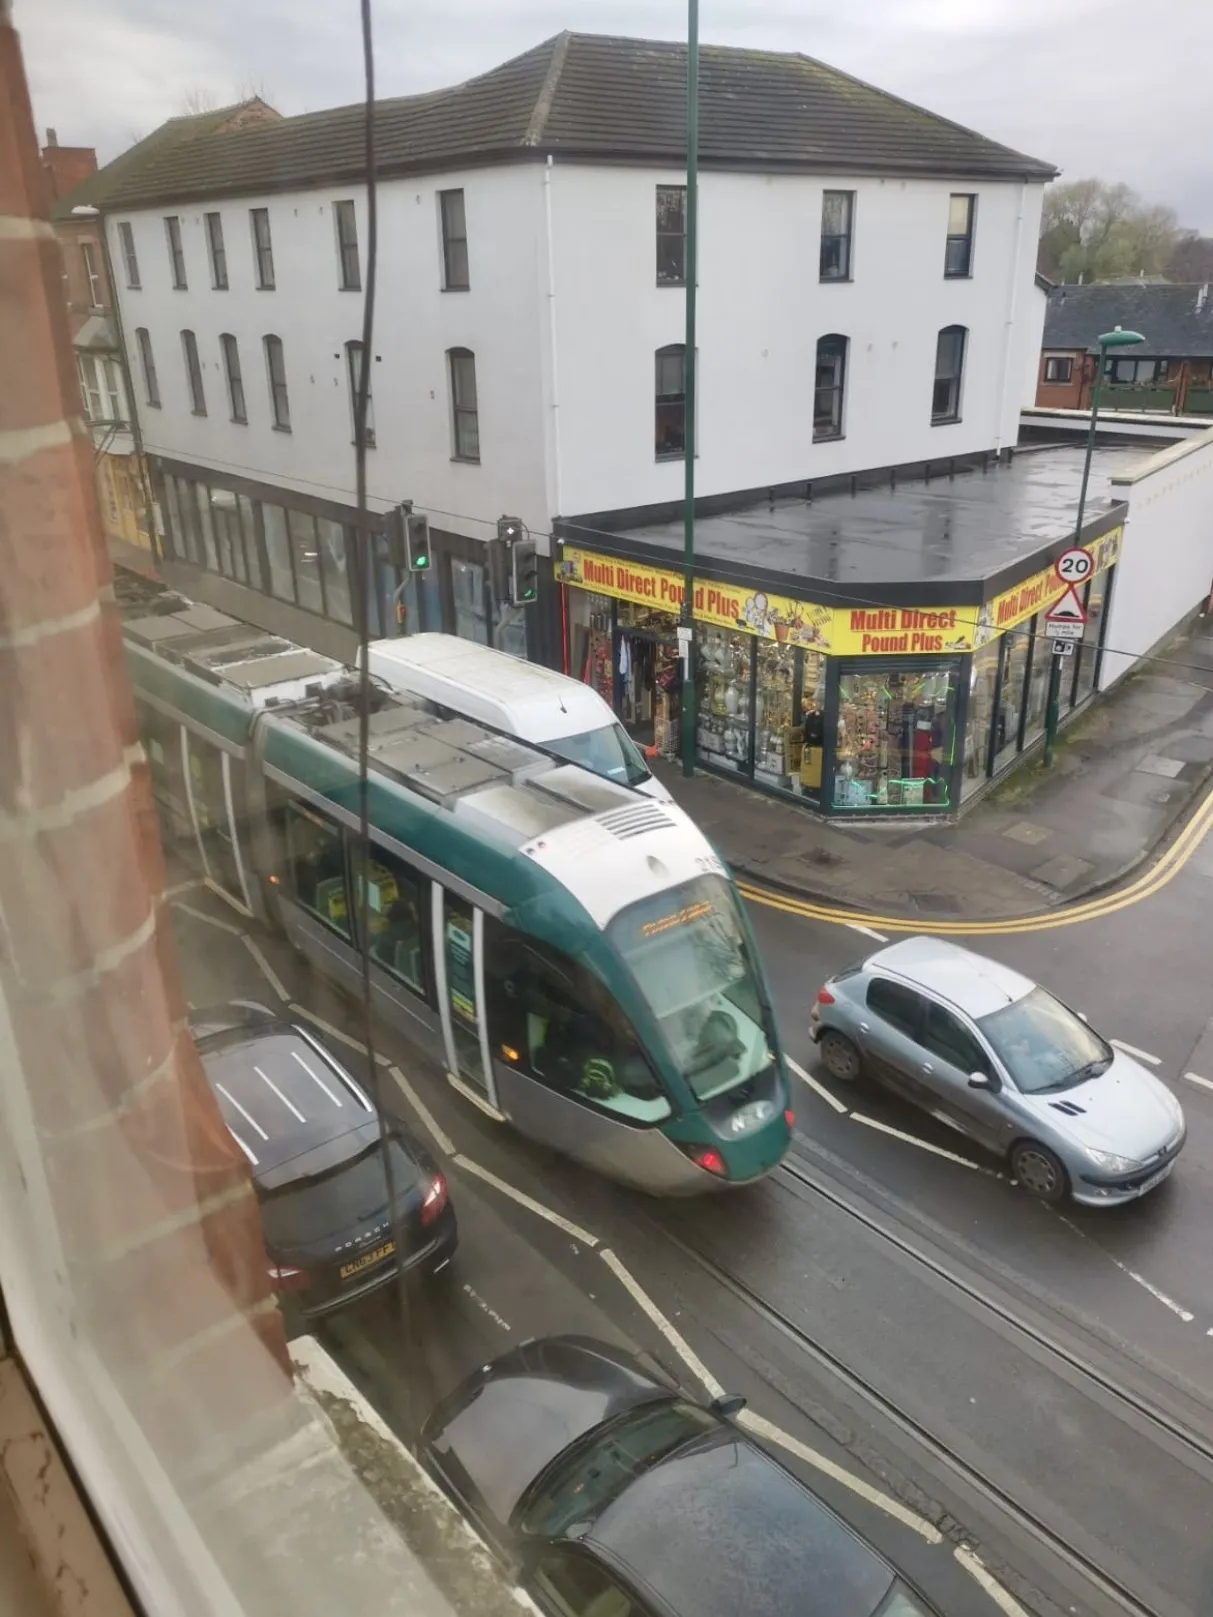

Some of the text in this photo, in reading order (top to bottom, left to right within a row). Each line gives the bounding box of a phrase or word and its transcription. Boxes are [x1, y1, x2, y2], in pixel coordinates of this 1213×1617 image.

[1061, 558, 1088, 574] 20
[583, 558, 614, 588] Multi
[617, 567, 656, 597] Direct
[661, 577, 704, 610] Poud
[707, 588, 740, 620] Plus
[850, 609, 896, 631] Multi
[901, 608, 956, 629] Direct
[861, 633, 942, 653] Pound Plus
